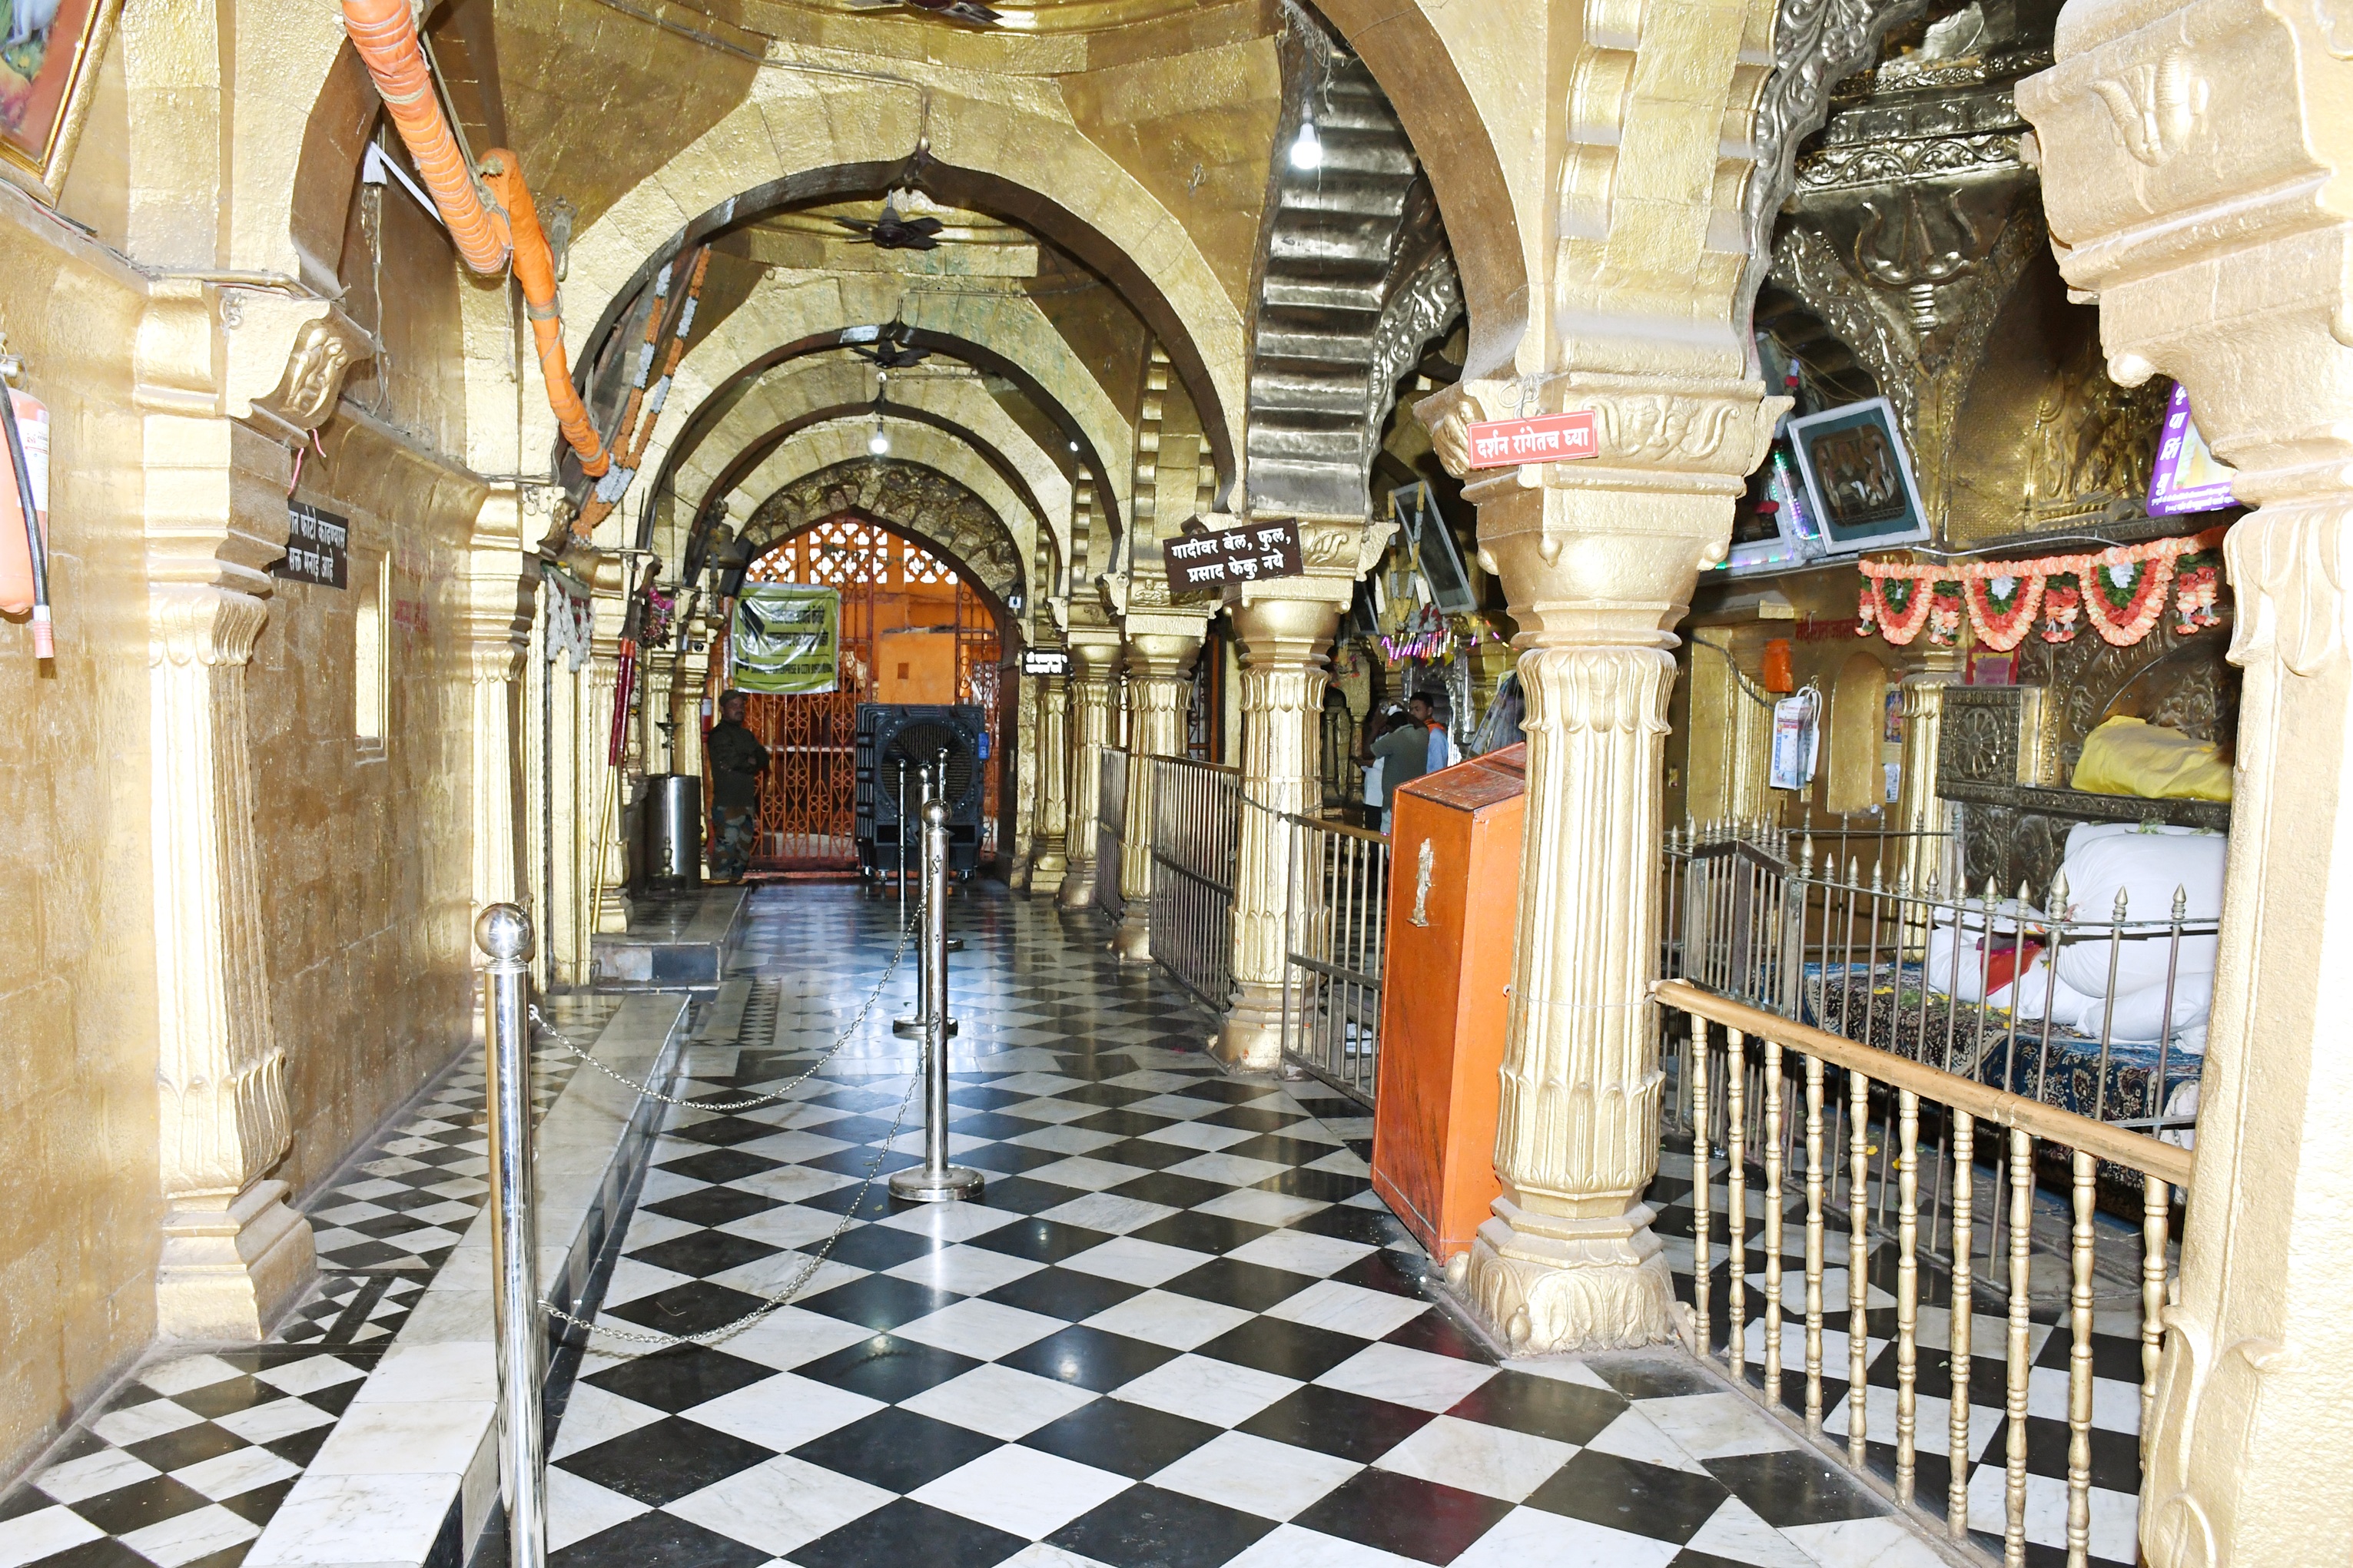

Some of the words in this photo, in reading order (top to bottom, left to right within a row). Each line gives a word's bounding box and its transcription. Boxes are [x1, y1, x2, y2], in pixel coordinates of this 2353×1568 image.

[1475, 429, 1510, 459] दर्शन
[1512, 425, 1560, 455] रांगेतच
[1562, 427, 1589, 446] घ्या
[300, 505, 317, 540] फोटो
[1171, 537, 1219, 559] गादीवर
[1222, 532, 1253, 551] बेल,
[1256, 527, 1291, 552] फुल,
[288, 546, 303, 572] सक्त
[303, 543, 320, 582] मनाई
[320, 547, 334, 583] आहे
[1186, 563, 1225, 582] प्रसाद
[1228, 555, 1258, 580] फेकु
[1261, 549, 1284, 570] नये
